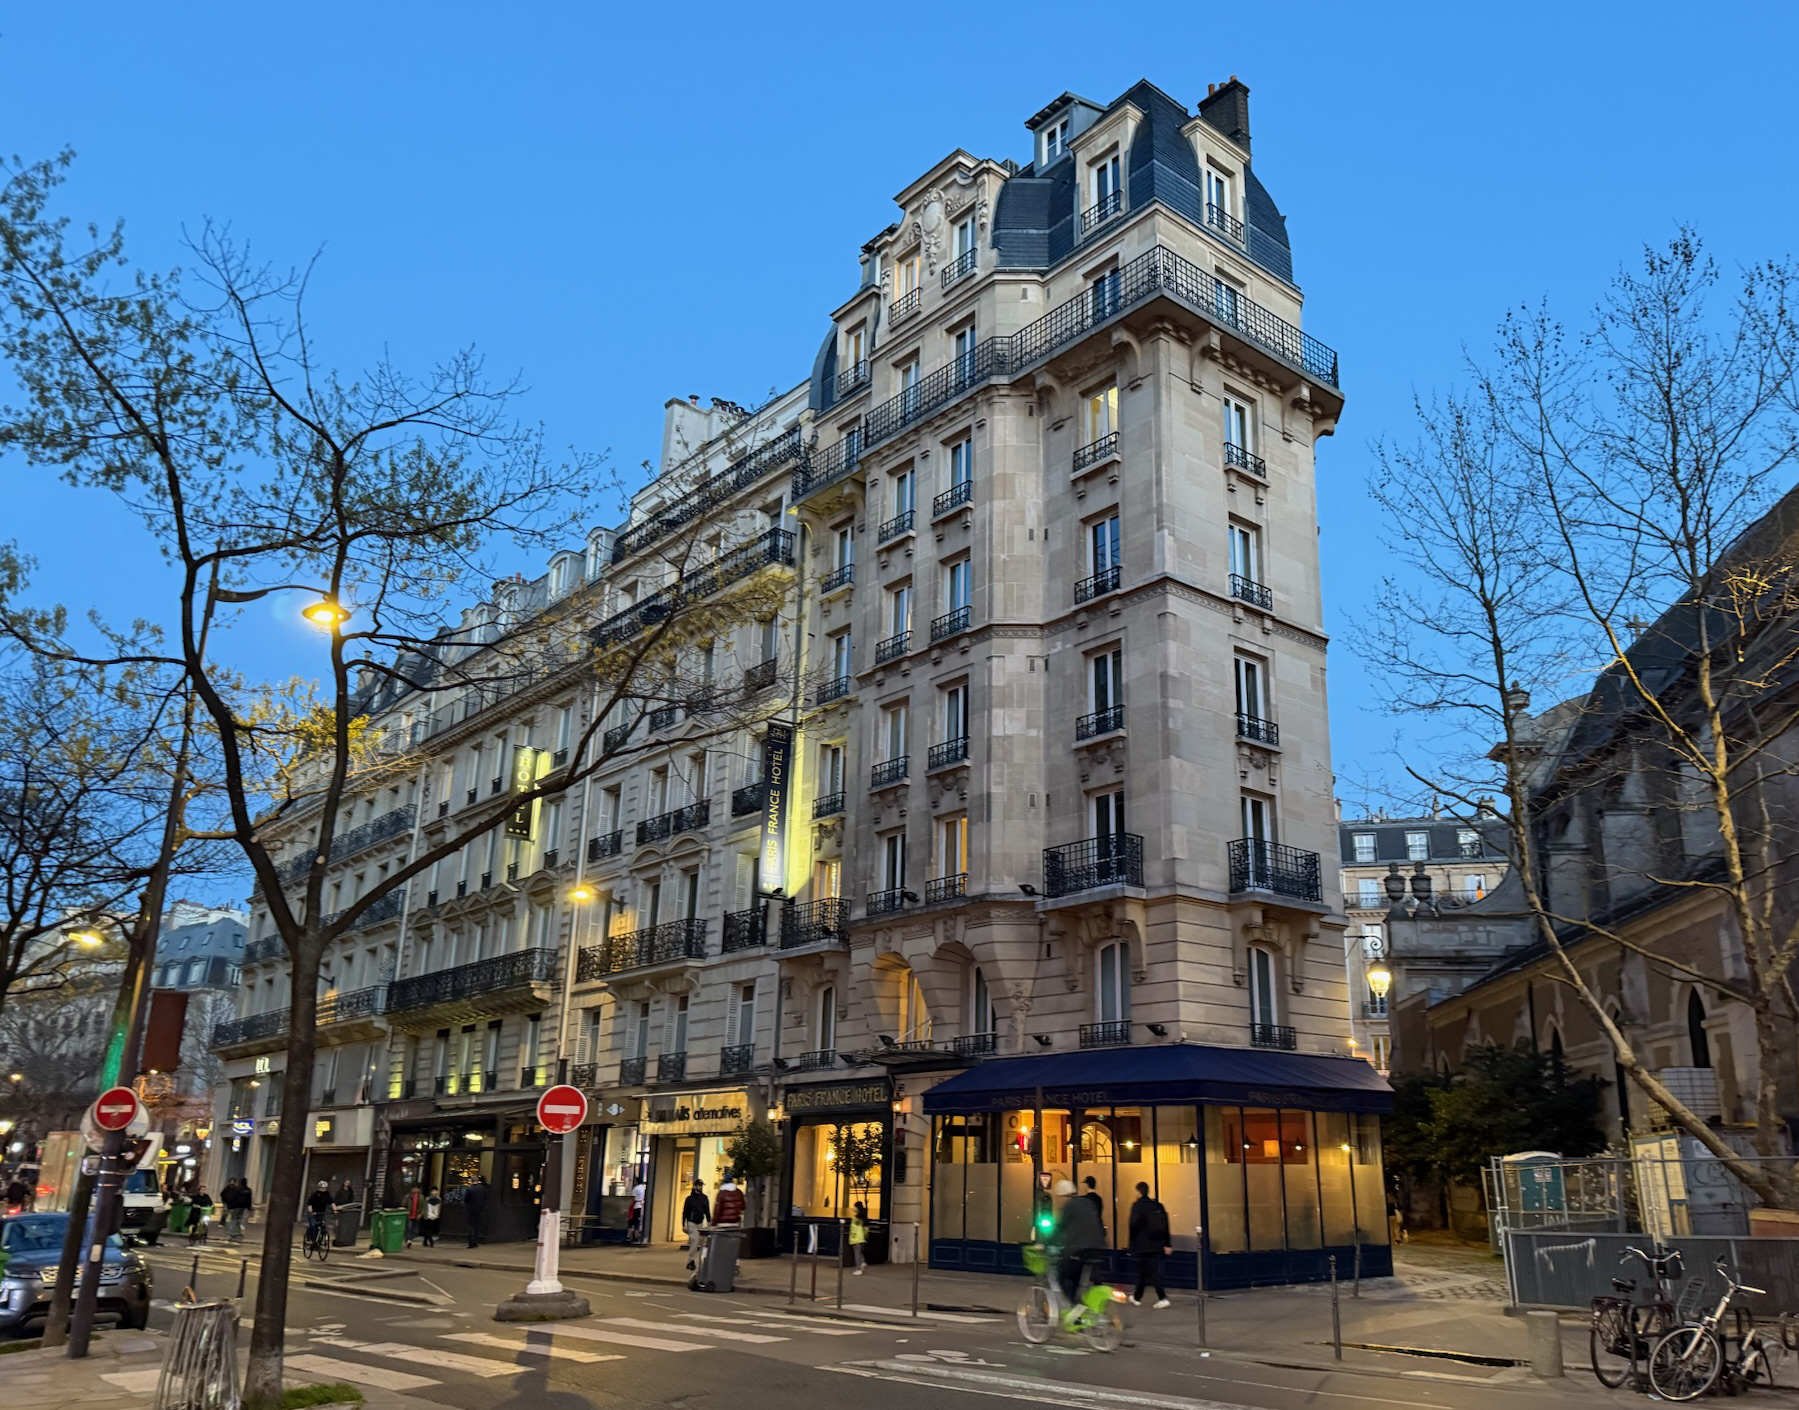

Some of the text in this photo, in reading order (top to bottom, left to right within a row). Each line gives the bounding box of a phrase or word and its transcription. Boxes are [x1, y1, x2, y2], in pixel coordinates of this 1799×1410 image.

[771, 748, 784, 785] HOTEL
[515, 757, 530, 823] HOTL
[767, 789, 780, 835] FRANCE
[693, 1105, 741, 1121] alternatives
[815, 1087, 851, 1106] FRANCE
[855, 1085, 888, 1103] HOTEL
